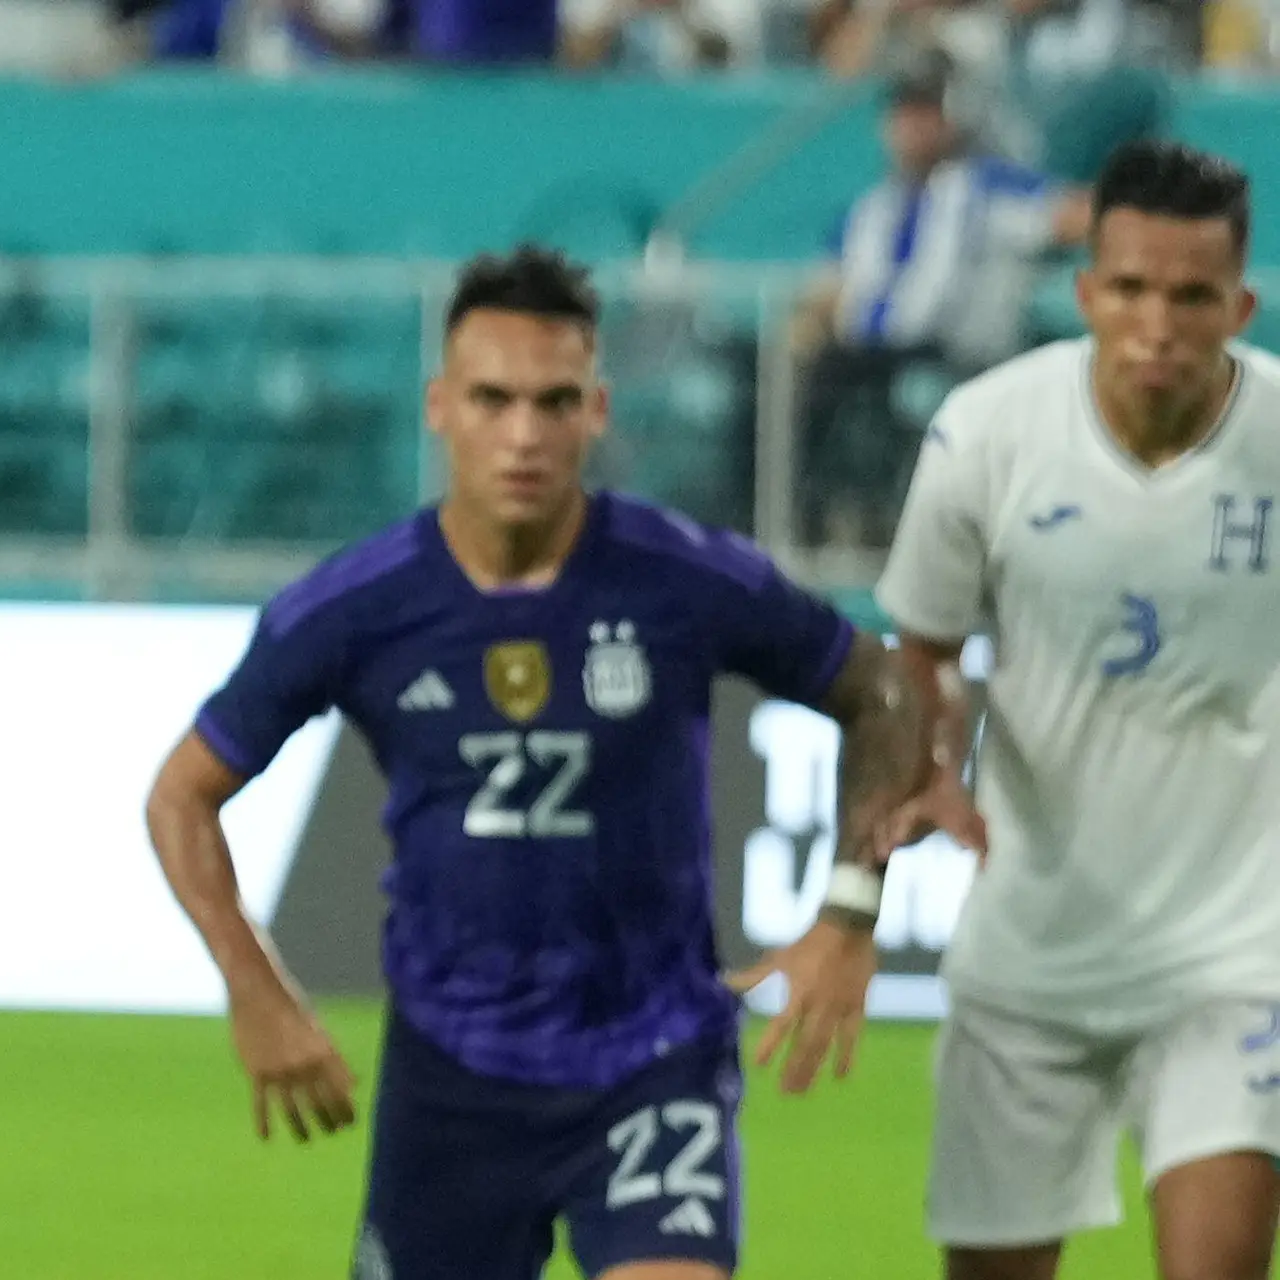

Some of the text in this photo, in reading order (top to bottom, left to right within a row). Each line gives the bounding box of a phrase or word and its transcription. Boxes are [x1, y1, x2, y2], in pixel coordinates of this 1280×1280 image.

[1208, 492, 1275, 574] H
[1102, 592, 1162, 678] 3
[457, 730, 596, 838] 22
[604, 1099, 726, 1210] 22
